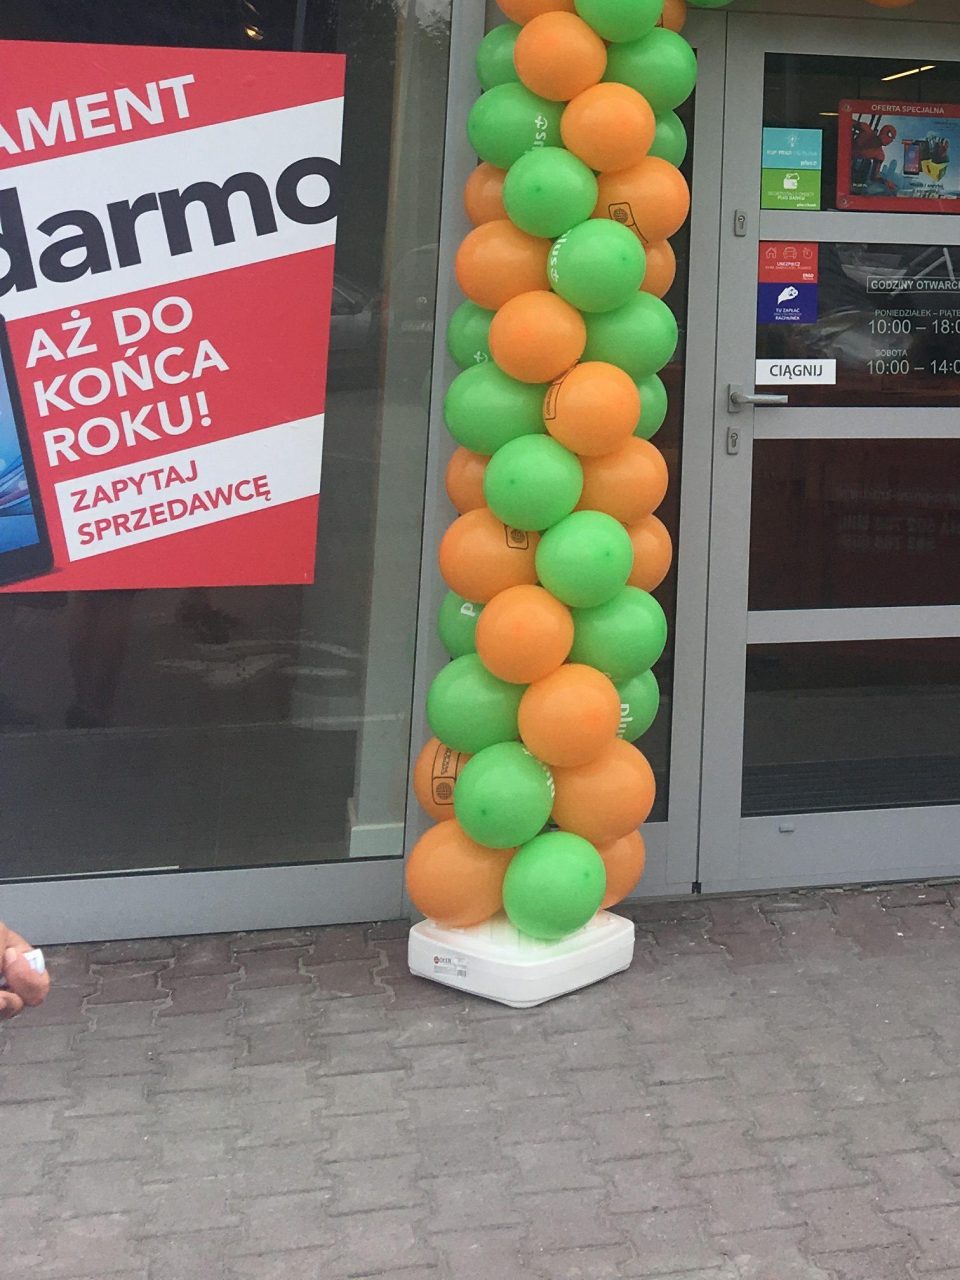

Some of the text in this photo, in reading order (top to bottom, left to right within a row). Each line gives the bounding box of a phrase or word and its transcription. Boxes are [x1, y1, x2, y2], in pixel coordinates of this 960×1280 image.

[871, 104, 945, 114] OFERTA SPECJALNA
[0, 156, 341, 298] darmo
[870, 280, 914, 290] GODZINY
[874, 309, 931, 317] PONIEDZIAŁEK
[26, 296, 193, 369] AŻ DO
[868, 319, 911, 334] 10:00
[875, 349, 908, 357] SOBOTA
[769, 363, 823, 380] CIĄGNIJ
[867, 360, 910, 375] 10:00
[33, 339, 230, 417] KOŃCA
[43, 391, 212, 467] ROKU!
[70, 460, 198, 513] ZAPYTAJ
[77, 474, 272, 546] SPRZEDAWCĘ
